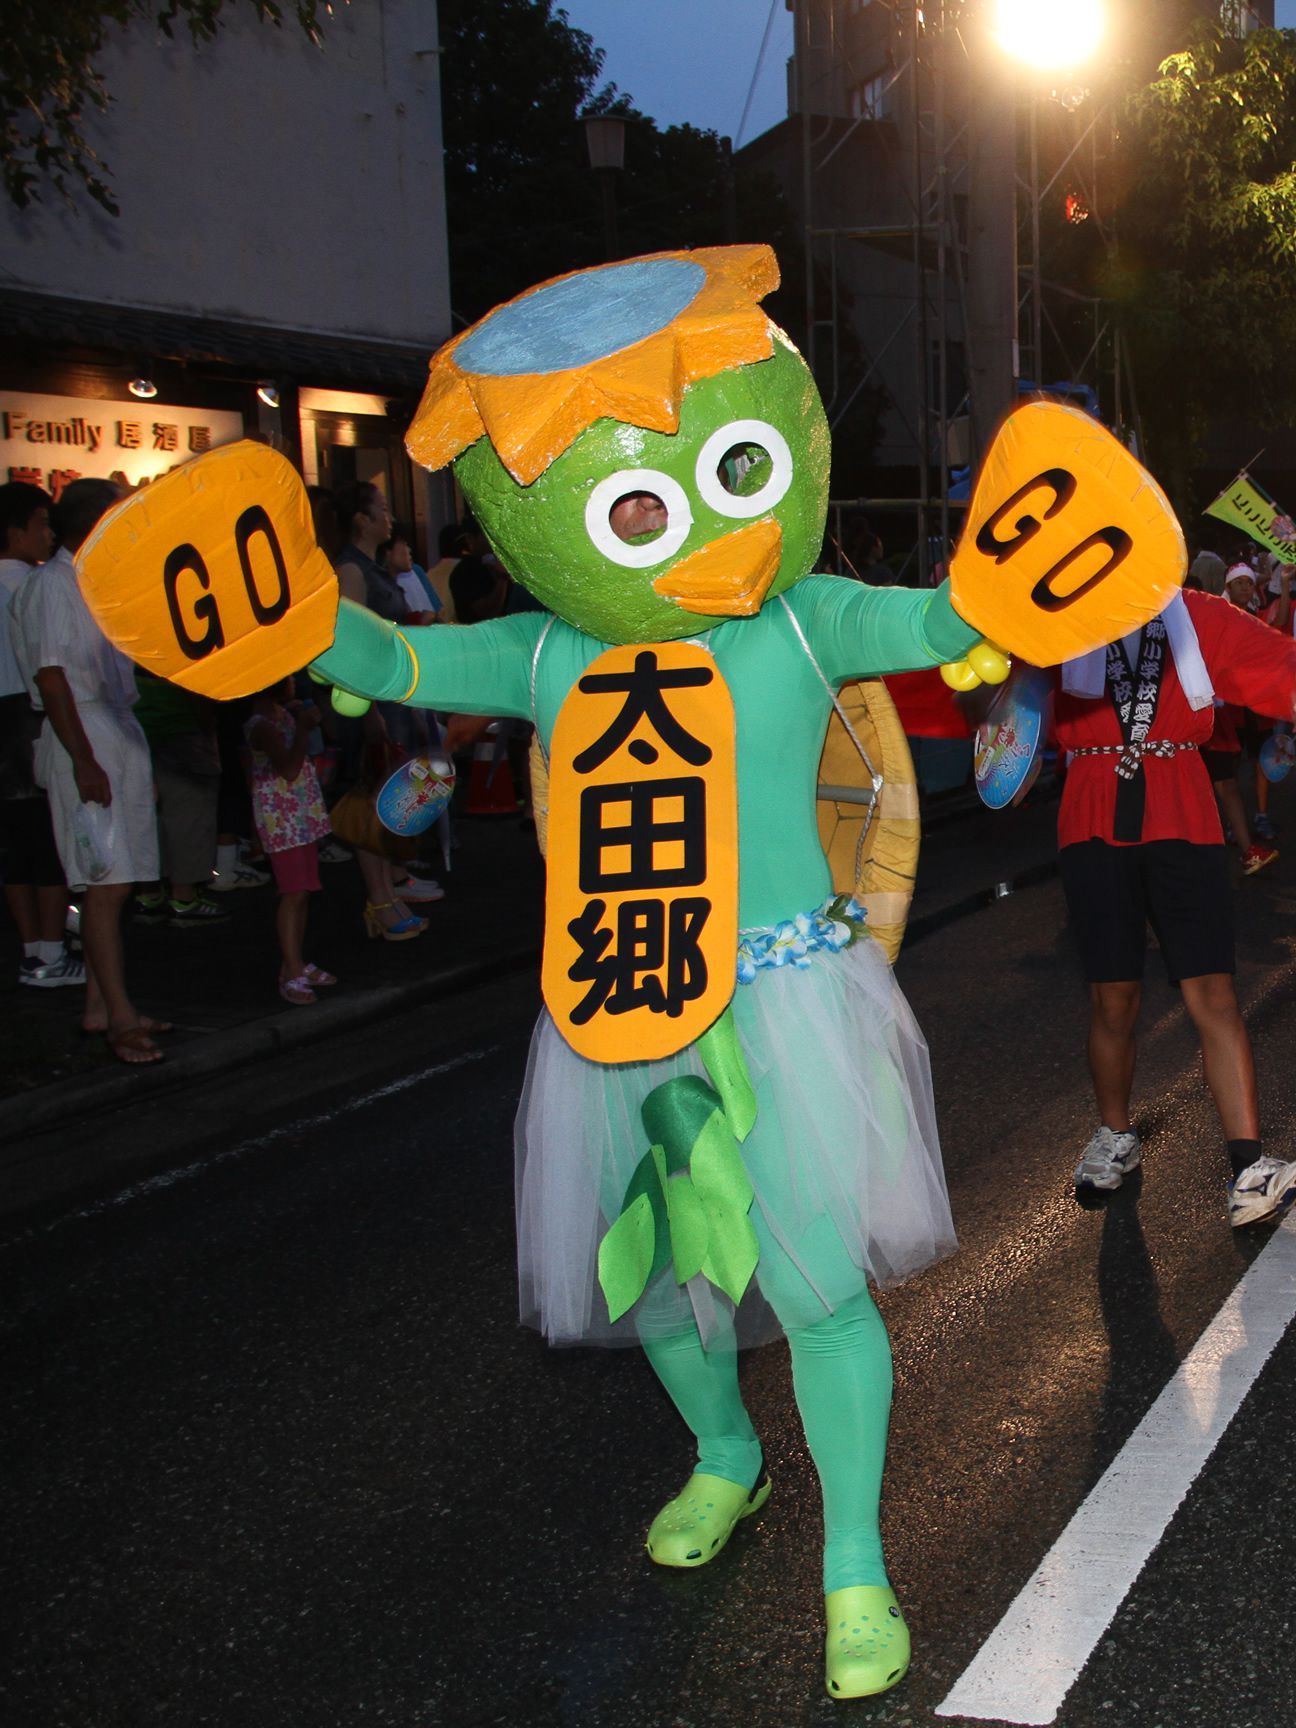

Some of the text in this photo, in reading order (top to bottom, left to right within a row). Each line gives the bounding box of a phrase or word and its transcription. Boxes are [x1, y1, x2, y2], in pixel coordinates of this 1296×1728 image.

[3, 411, 211, 452] Family 居酒屋
[164, 505, 291, 661] GO
[976, 468, 1134, 613] GO
[567, 650, 714, 1026] 太田郷
